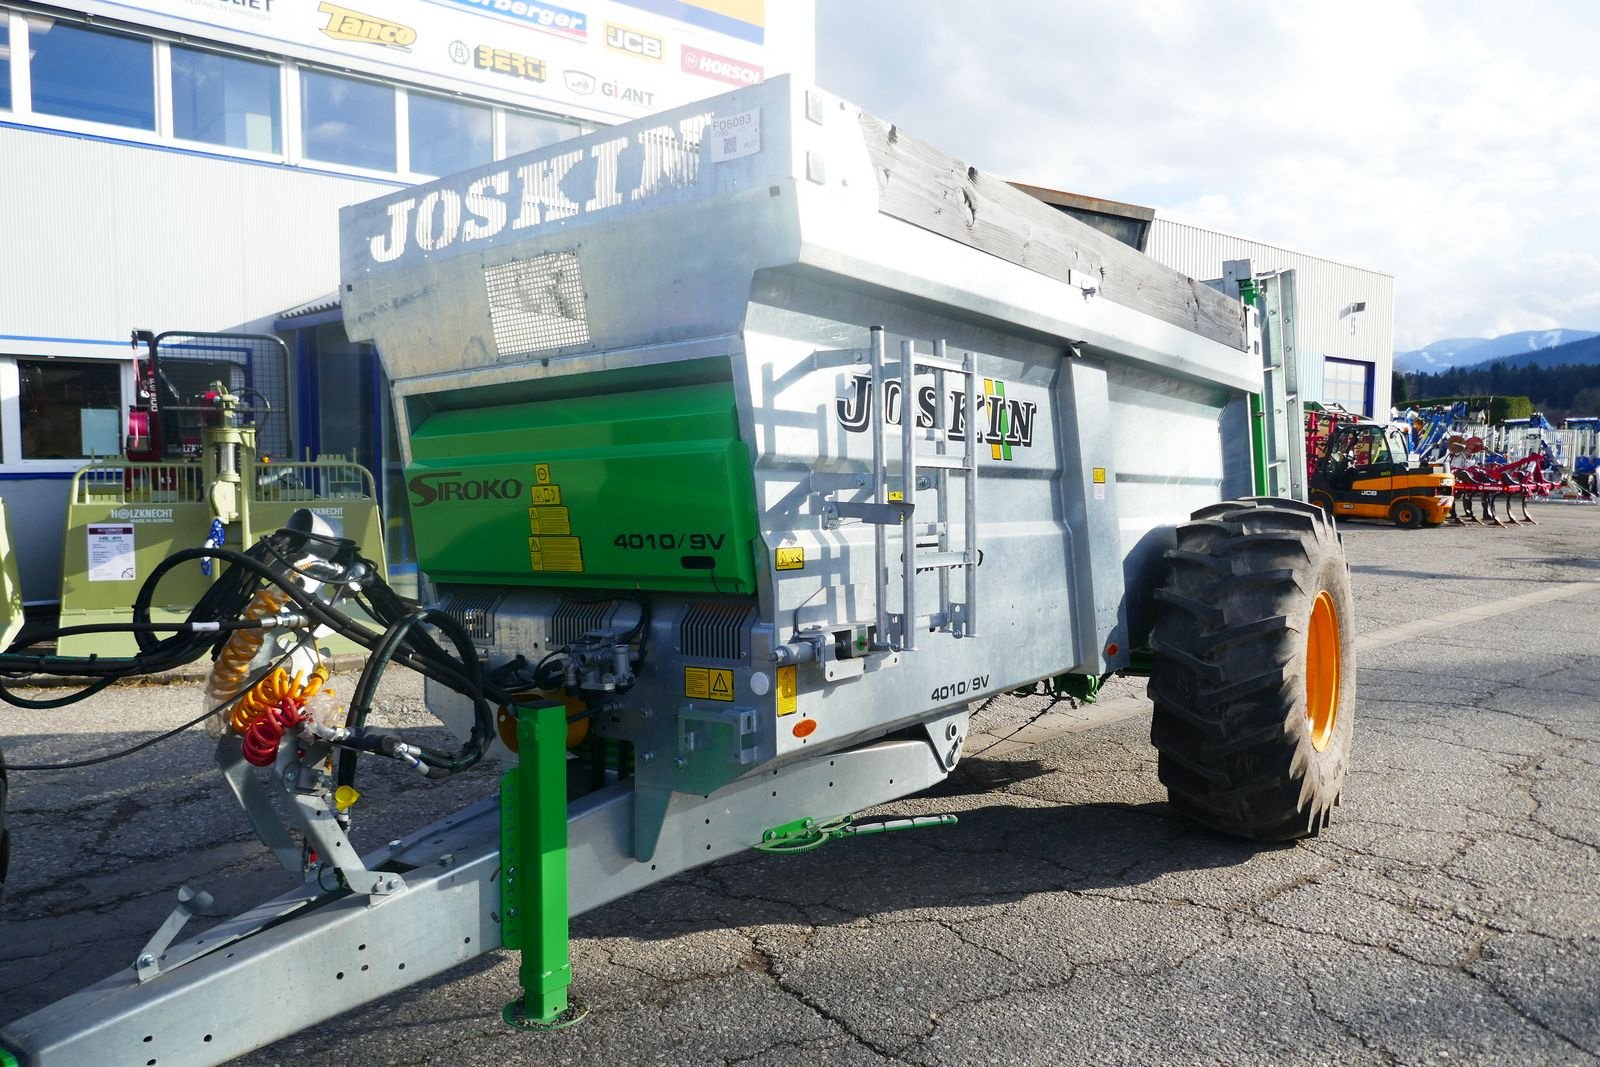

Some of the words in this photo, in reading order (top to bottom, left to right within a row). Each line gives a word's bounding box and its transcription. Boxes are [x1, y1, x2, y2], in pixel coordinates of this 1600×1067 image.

[607, 25, 662, 59] JCB
[699, 56, 761, 85] HORSCH
[370, 111, 715, 263] JOSKIN
[409, 471, 522, 507] SIROKO
[614, 533, 725, 550] 4010/9V
[931, 674, 989, 701] 4010/9V
